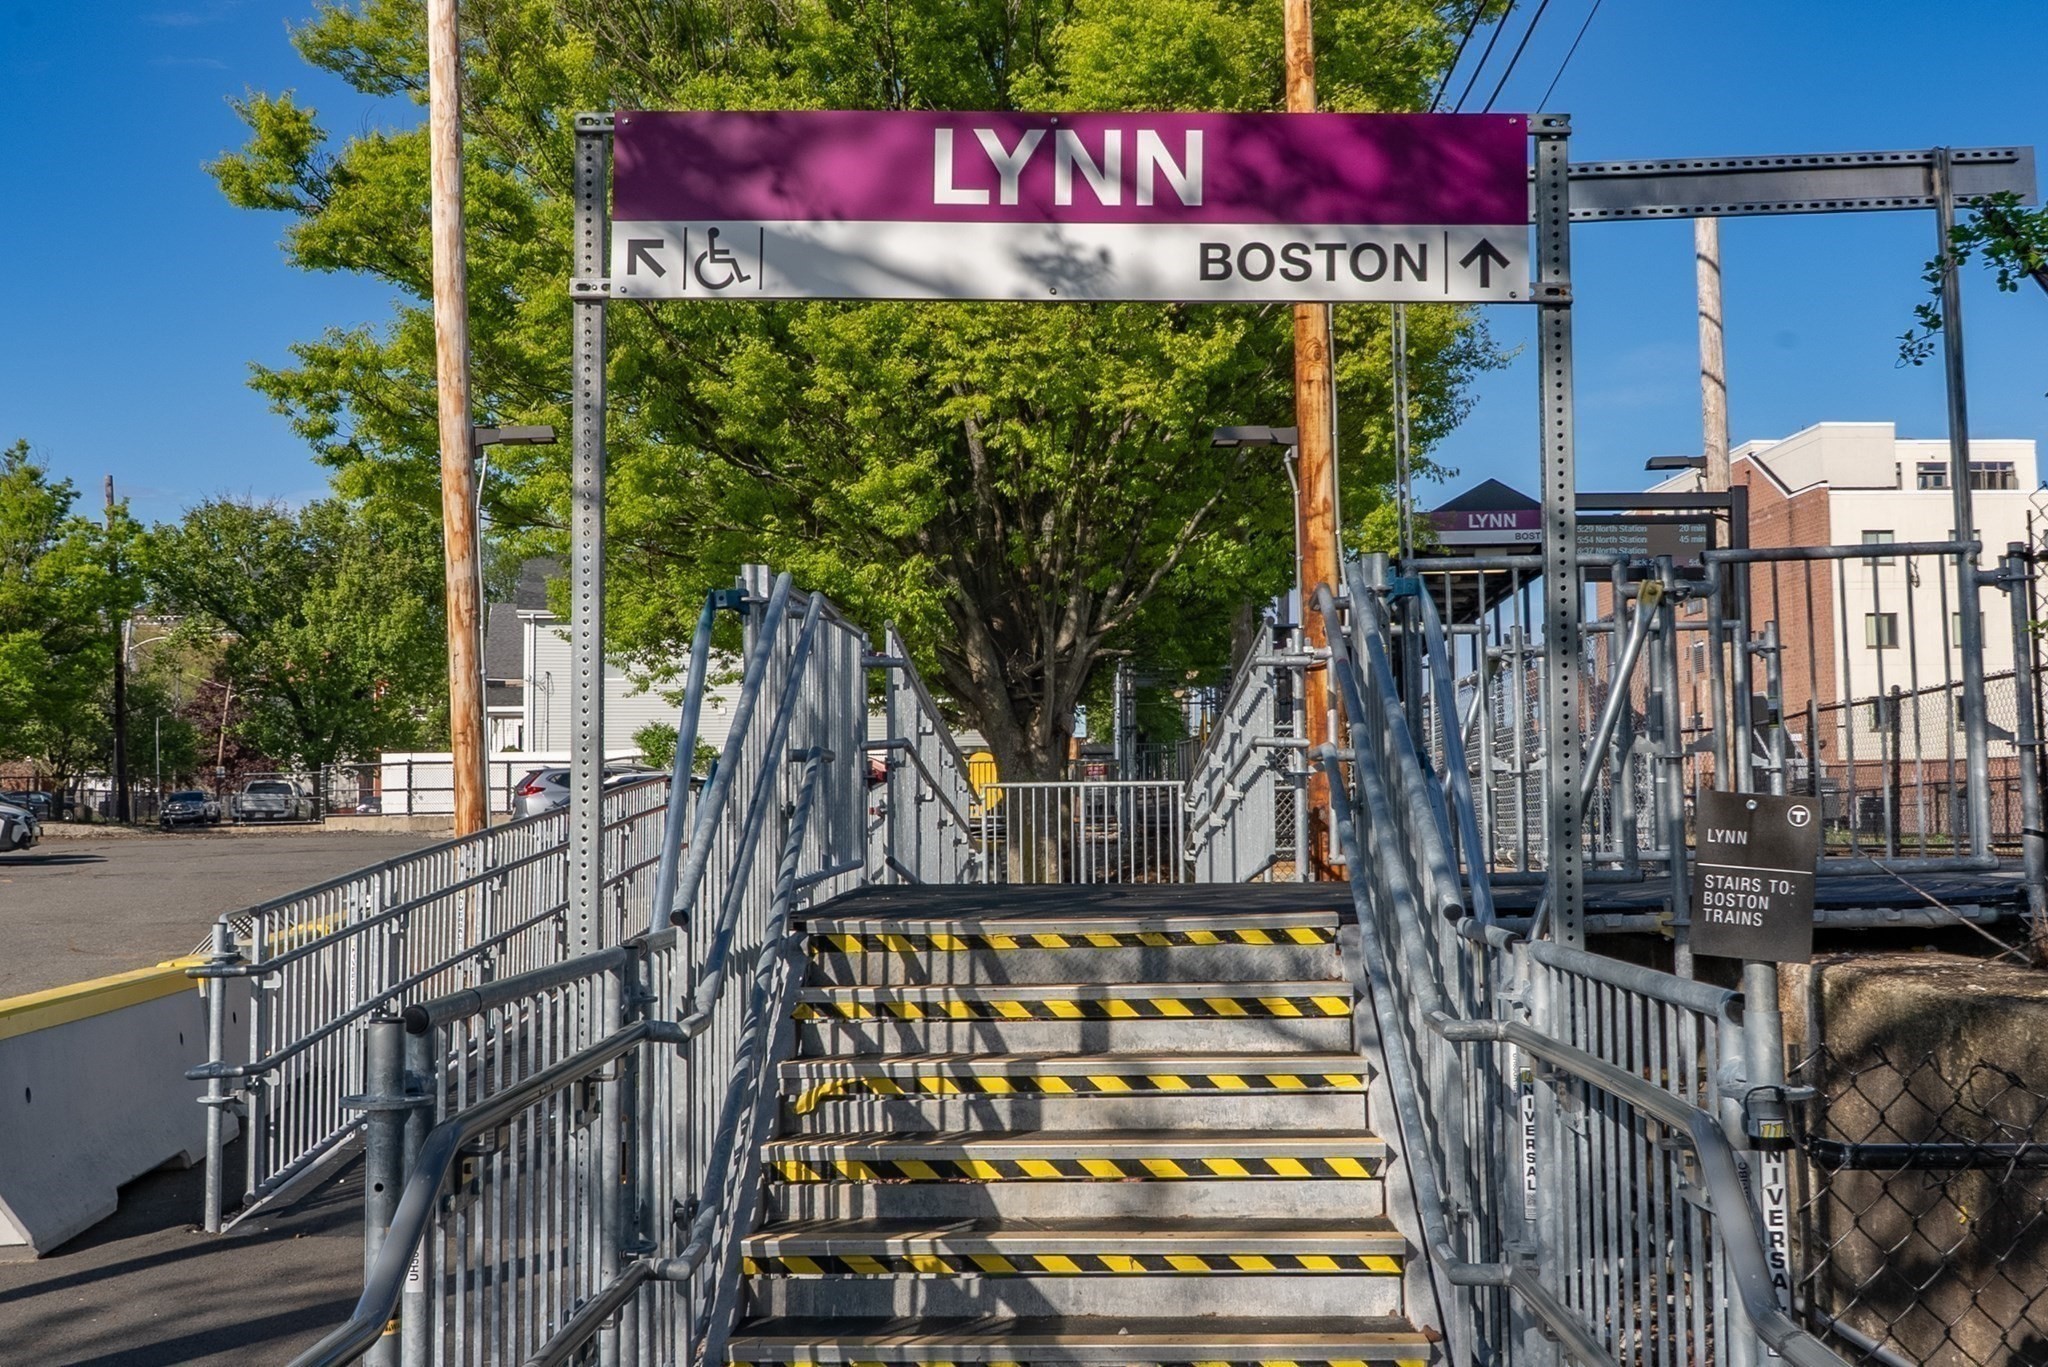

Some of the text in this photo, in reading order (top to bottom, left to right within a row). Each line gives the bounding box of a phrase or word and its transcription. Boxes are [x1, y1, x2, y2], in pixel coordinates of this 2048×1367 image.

[934, 128, 1203, 206] LYNN
[1199, 242, 1428, 282] BOSTON
[1468, 513, 1517, 529] LYNN
[1595, 525, 1617, 533] North
[1619, 525, 1648, 533] Station
[1690, 524, 1707, 532] min
[1515, 532, 1541, 541] BOST
[1595, 536, 1617, 544] North
[1619, 536, 1648, 544] Station
[1690, 535, 1707, 543] min
[1619, 546, 1648, 554] Station
[1707, 828, 1748, 845] LYNN
[1704, 874, 1796, 895] STAIRS TO:
[1703, 892, 1769, 910] BOSTON
[1703, 908, 1763, 927] TRAINS
